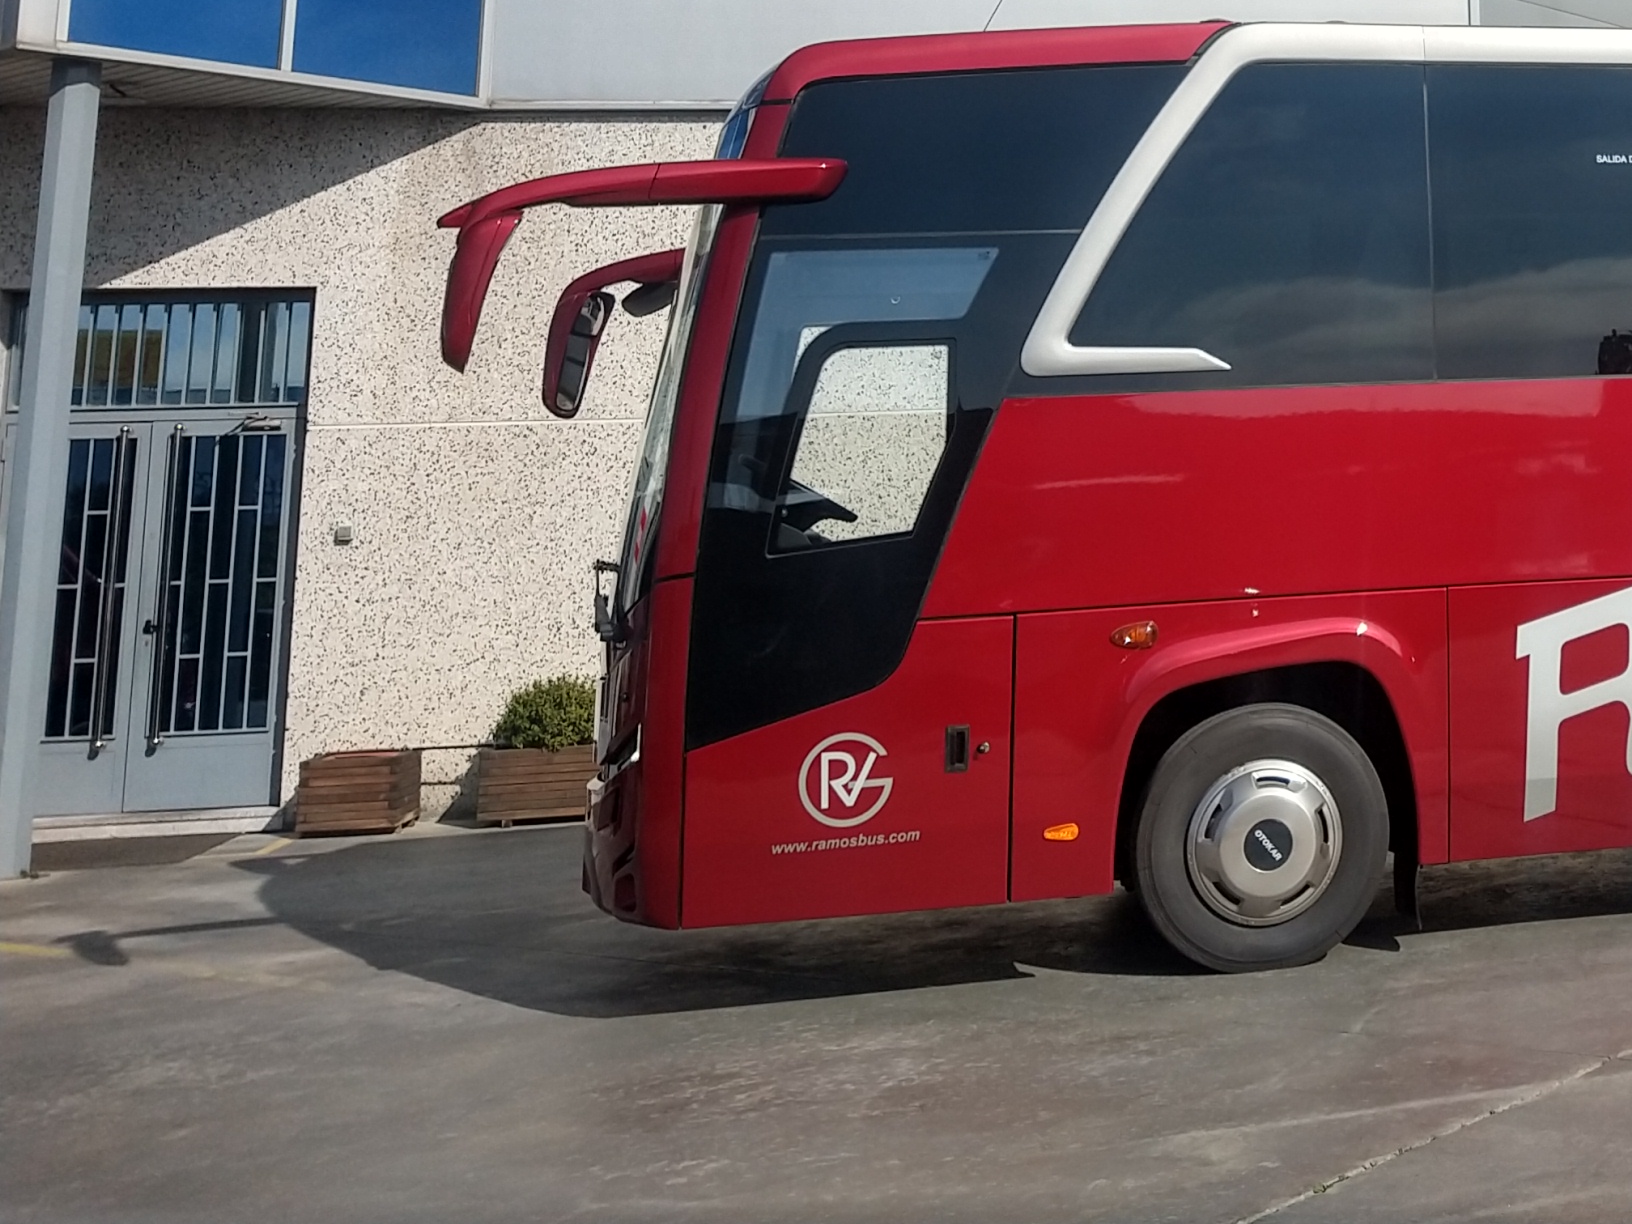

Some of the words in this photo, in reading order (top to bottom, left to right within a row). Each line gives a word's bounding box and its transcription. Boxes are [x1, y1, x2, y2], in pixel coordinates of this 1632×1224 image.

[1596, 155, 1627, 163] SALIDA
[771, 830, 921, 855] www.ramosbus.com
[1254, 829, 1283, 862] OTOKAR
